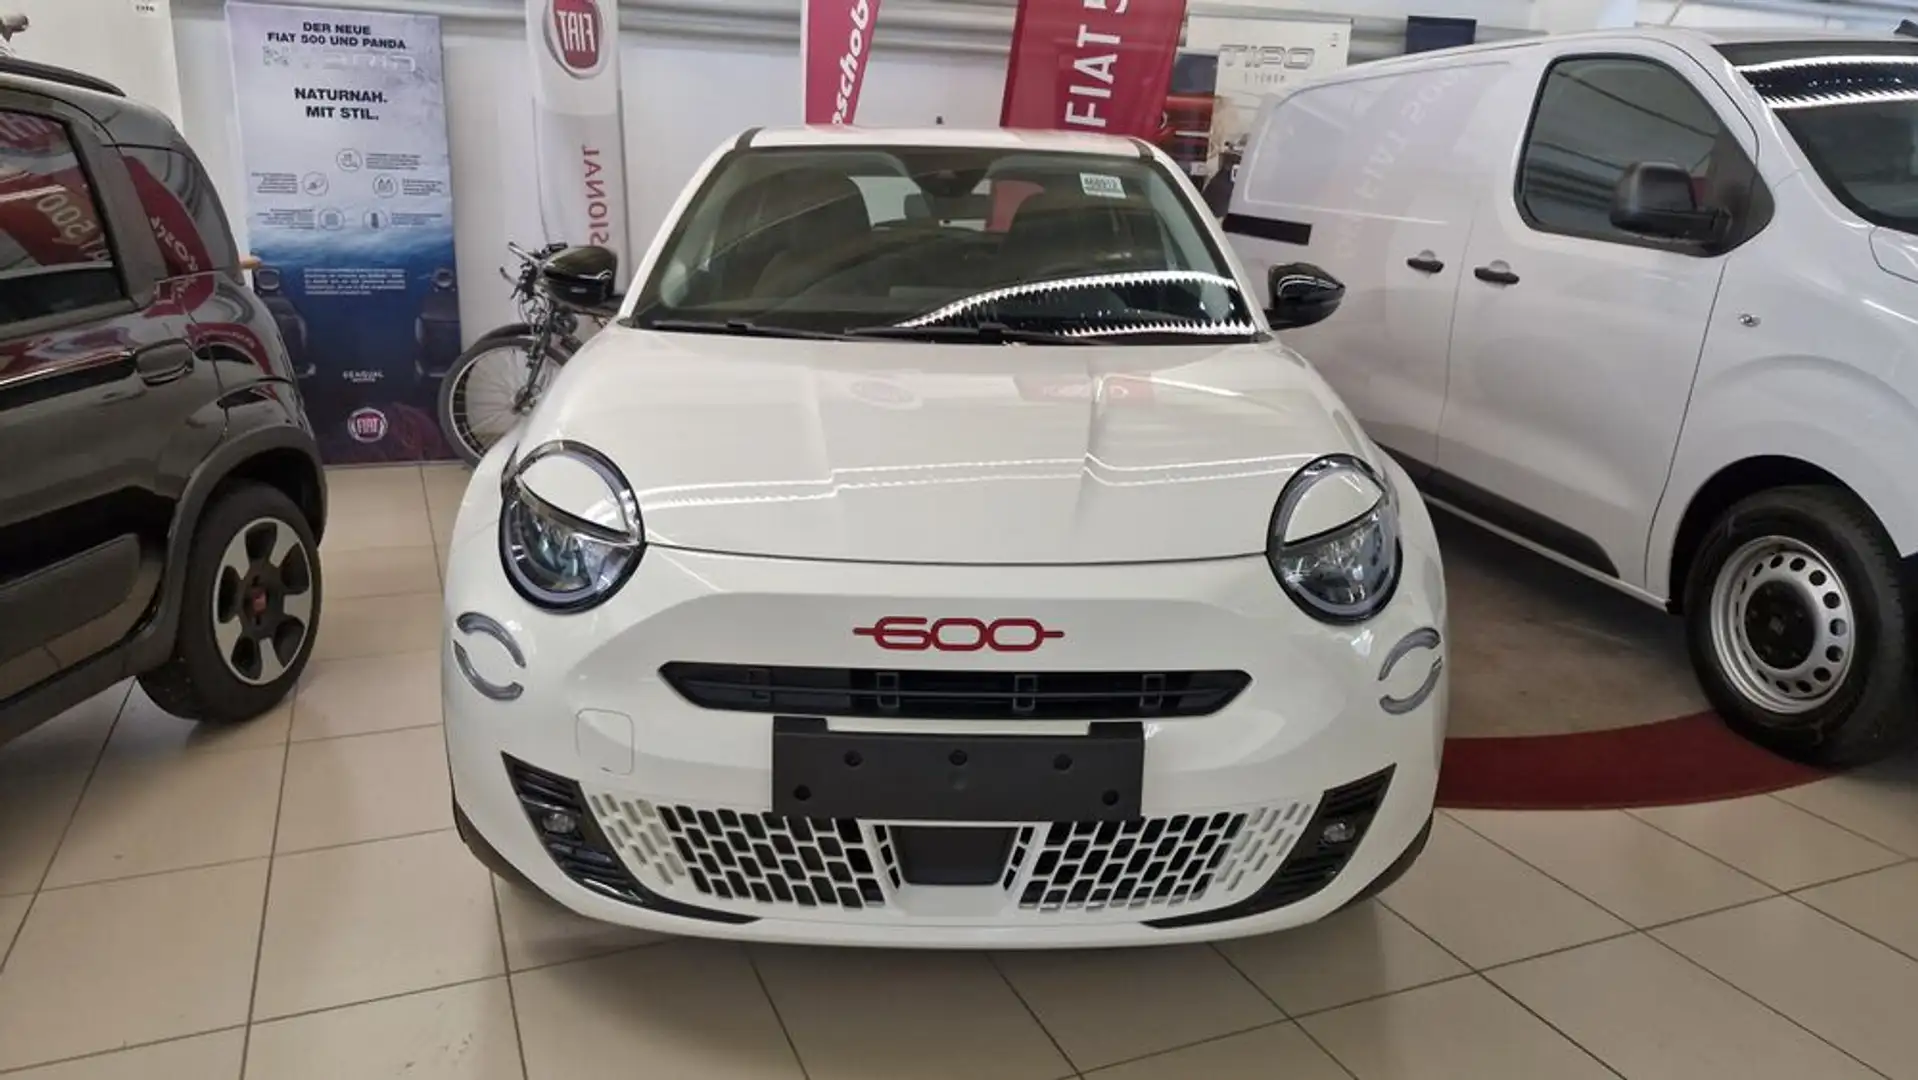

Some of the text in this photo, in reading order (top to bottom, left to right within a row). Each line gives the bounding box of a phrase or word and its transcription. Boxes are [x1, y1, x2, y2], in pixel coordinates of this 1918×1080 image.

[303, 21, 371, 35] DER NEUE
[267, 32, 407, 50] FIAT 500 UND PANDA
[1219, 44, 1316, 70] TIPO
[1065, 24, 1121, 127] FIAT
[293, 87, 388, 103] NATURNAH.
[305, 105, 379, 121] MIT STIL.
[356, 418, 379, 434] FIAT
[872, 616, 1046, 651] 600
